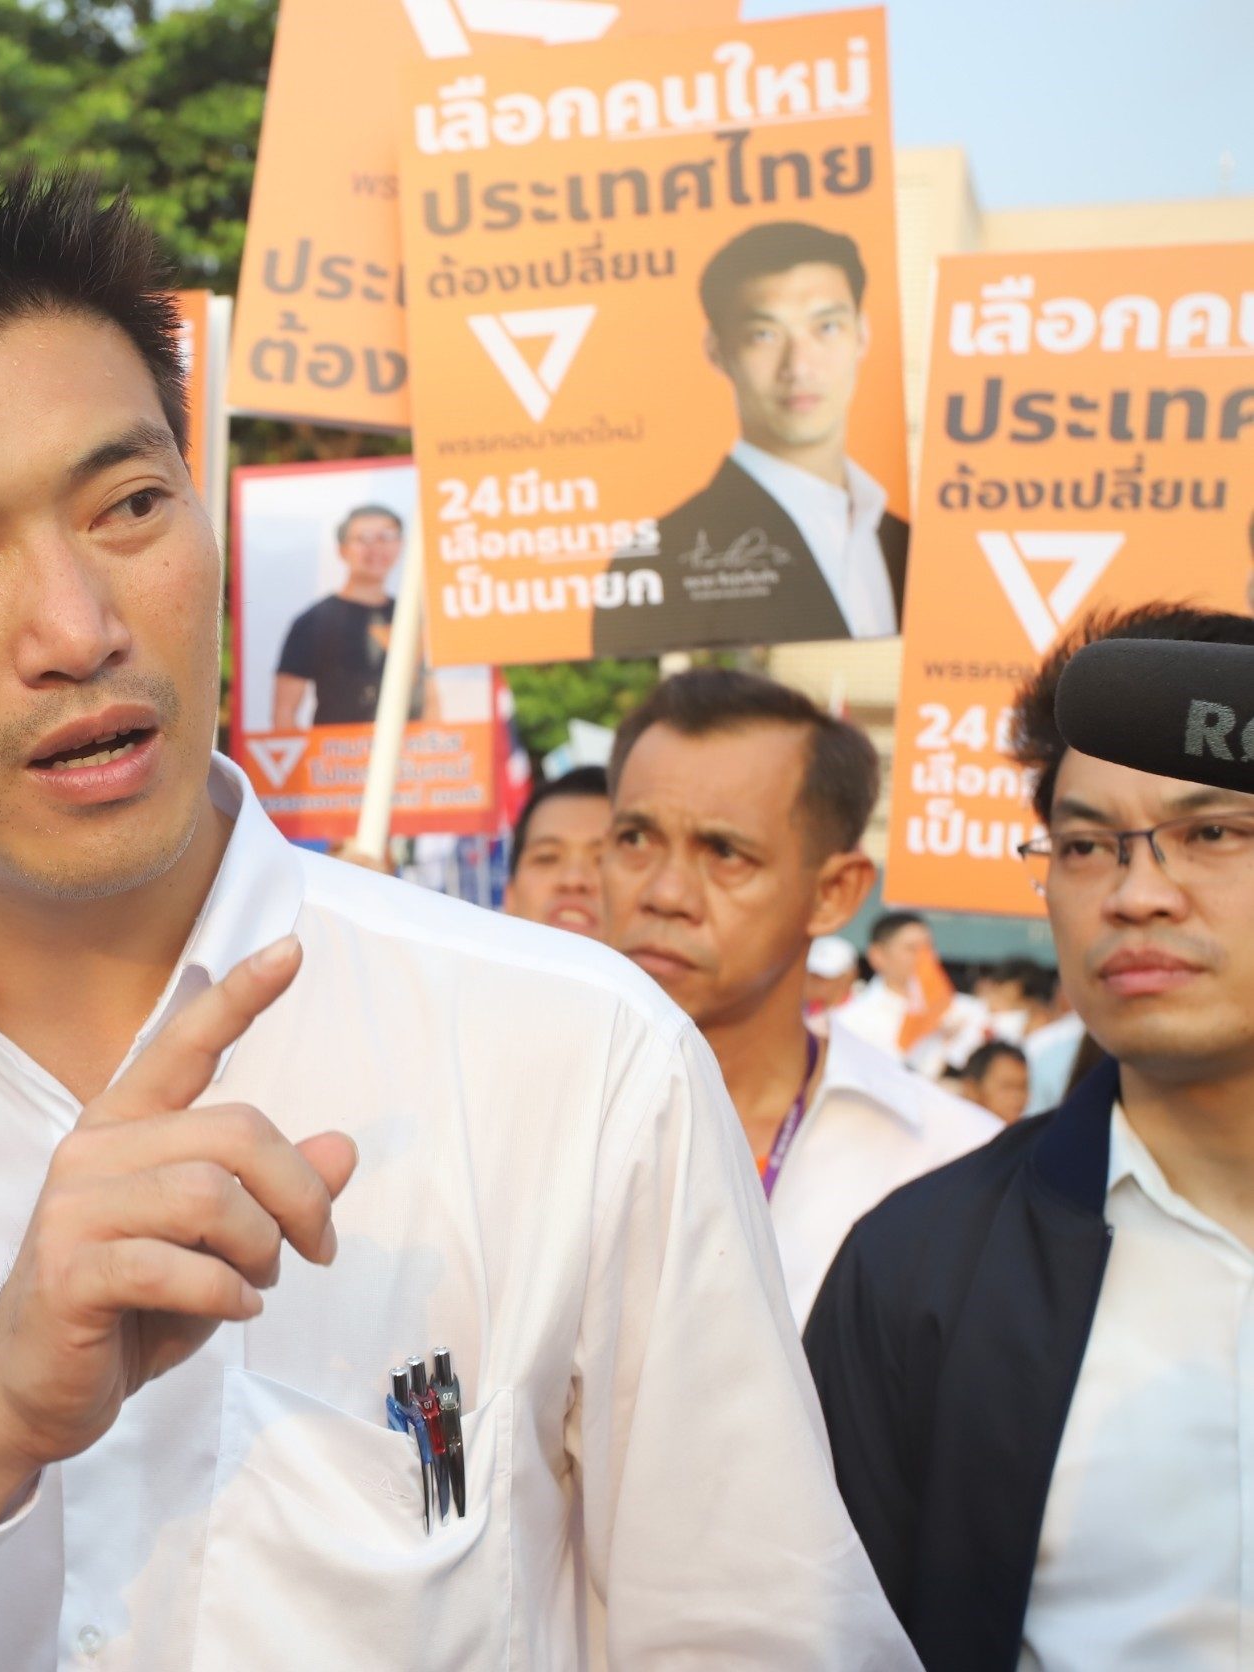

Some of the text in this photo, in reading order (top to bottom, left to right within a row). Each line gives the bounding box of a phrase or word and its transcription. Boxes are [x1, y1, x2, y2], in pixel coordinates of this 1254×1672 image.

[414, 37, 870, 154] เลือกคนใหม่
[421, 129, 874, 236] ประเทศไทย
[427, 231, 676, 300] ต้องเปลี่ยน
[948, 274, 1254, 357] เลือกค
[937, 453, 1229, 512] ต้องเปลี่ยน
[439, 517, 661, 564] เลือกธนาธร
[441, 565, 665, 619] เป็นนายก
[1185, 699, 1254, 762] R
[442, 1392, 453, 1401] 07
